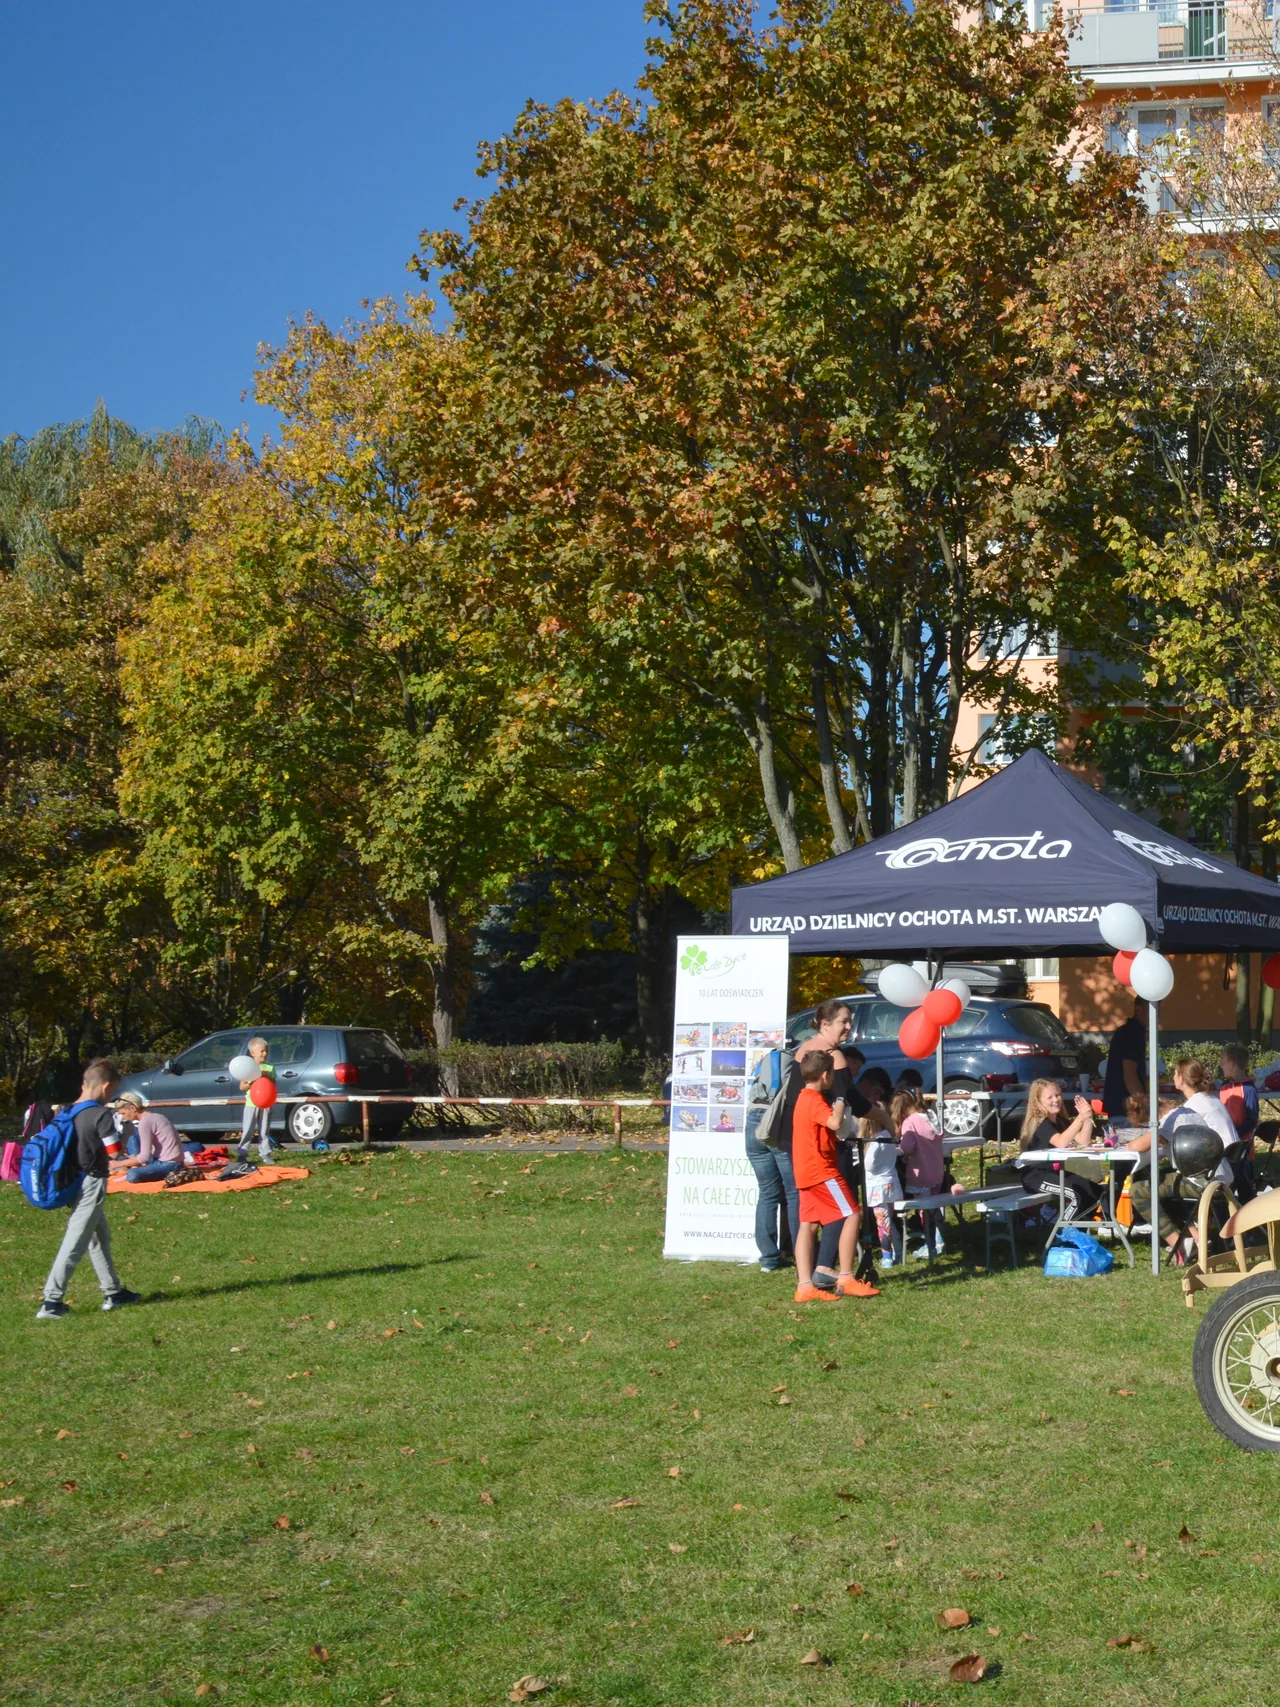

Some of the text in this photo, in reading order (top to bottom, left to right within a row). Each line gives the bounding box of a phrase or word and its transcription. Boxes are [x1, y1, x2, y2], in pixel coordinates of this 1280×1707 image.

[875, 830, 1072, 869] Ochota
[750, 906, 1108, 933] URZĄD DZIELNICY OCHOTA M.ST. WARSZA
[1224, 909, 1251, 925] OCHOTA
[707, 989, 718, 997] LAT
[675, 1157, 756, 1176] STOWARZYSZE
[683, 1185, 758, 1206] NA CAŁE ŻYCI
[683, 1230, 756, 1240] WWW.NACALEZYCIE.OR
